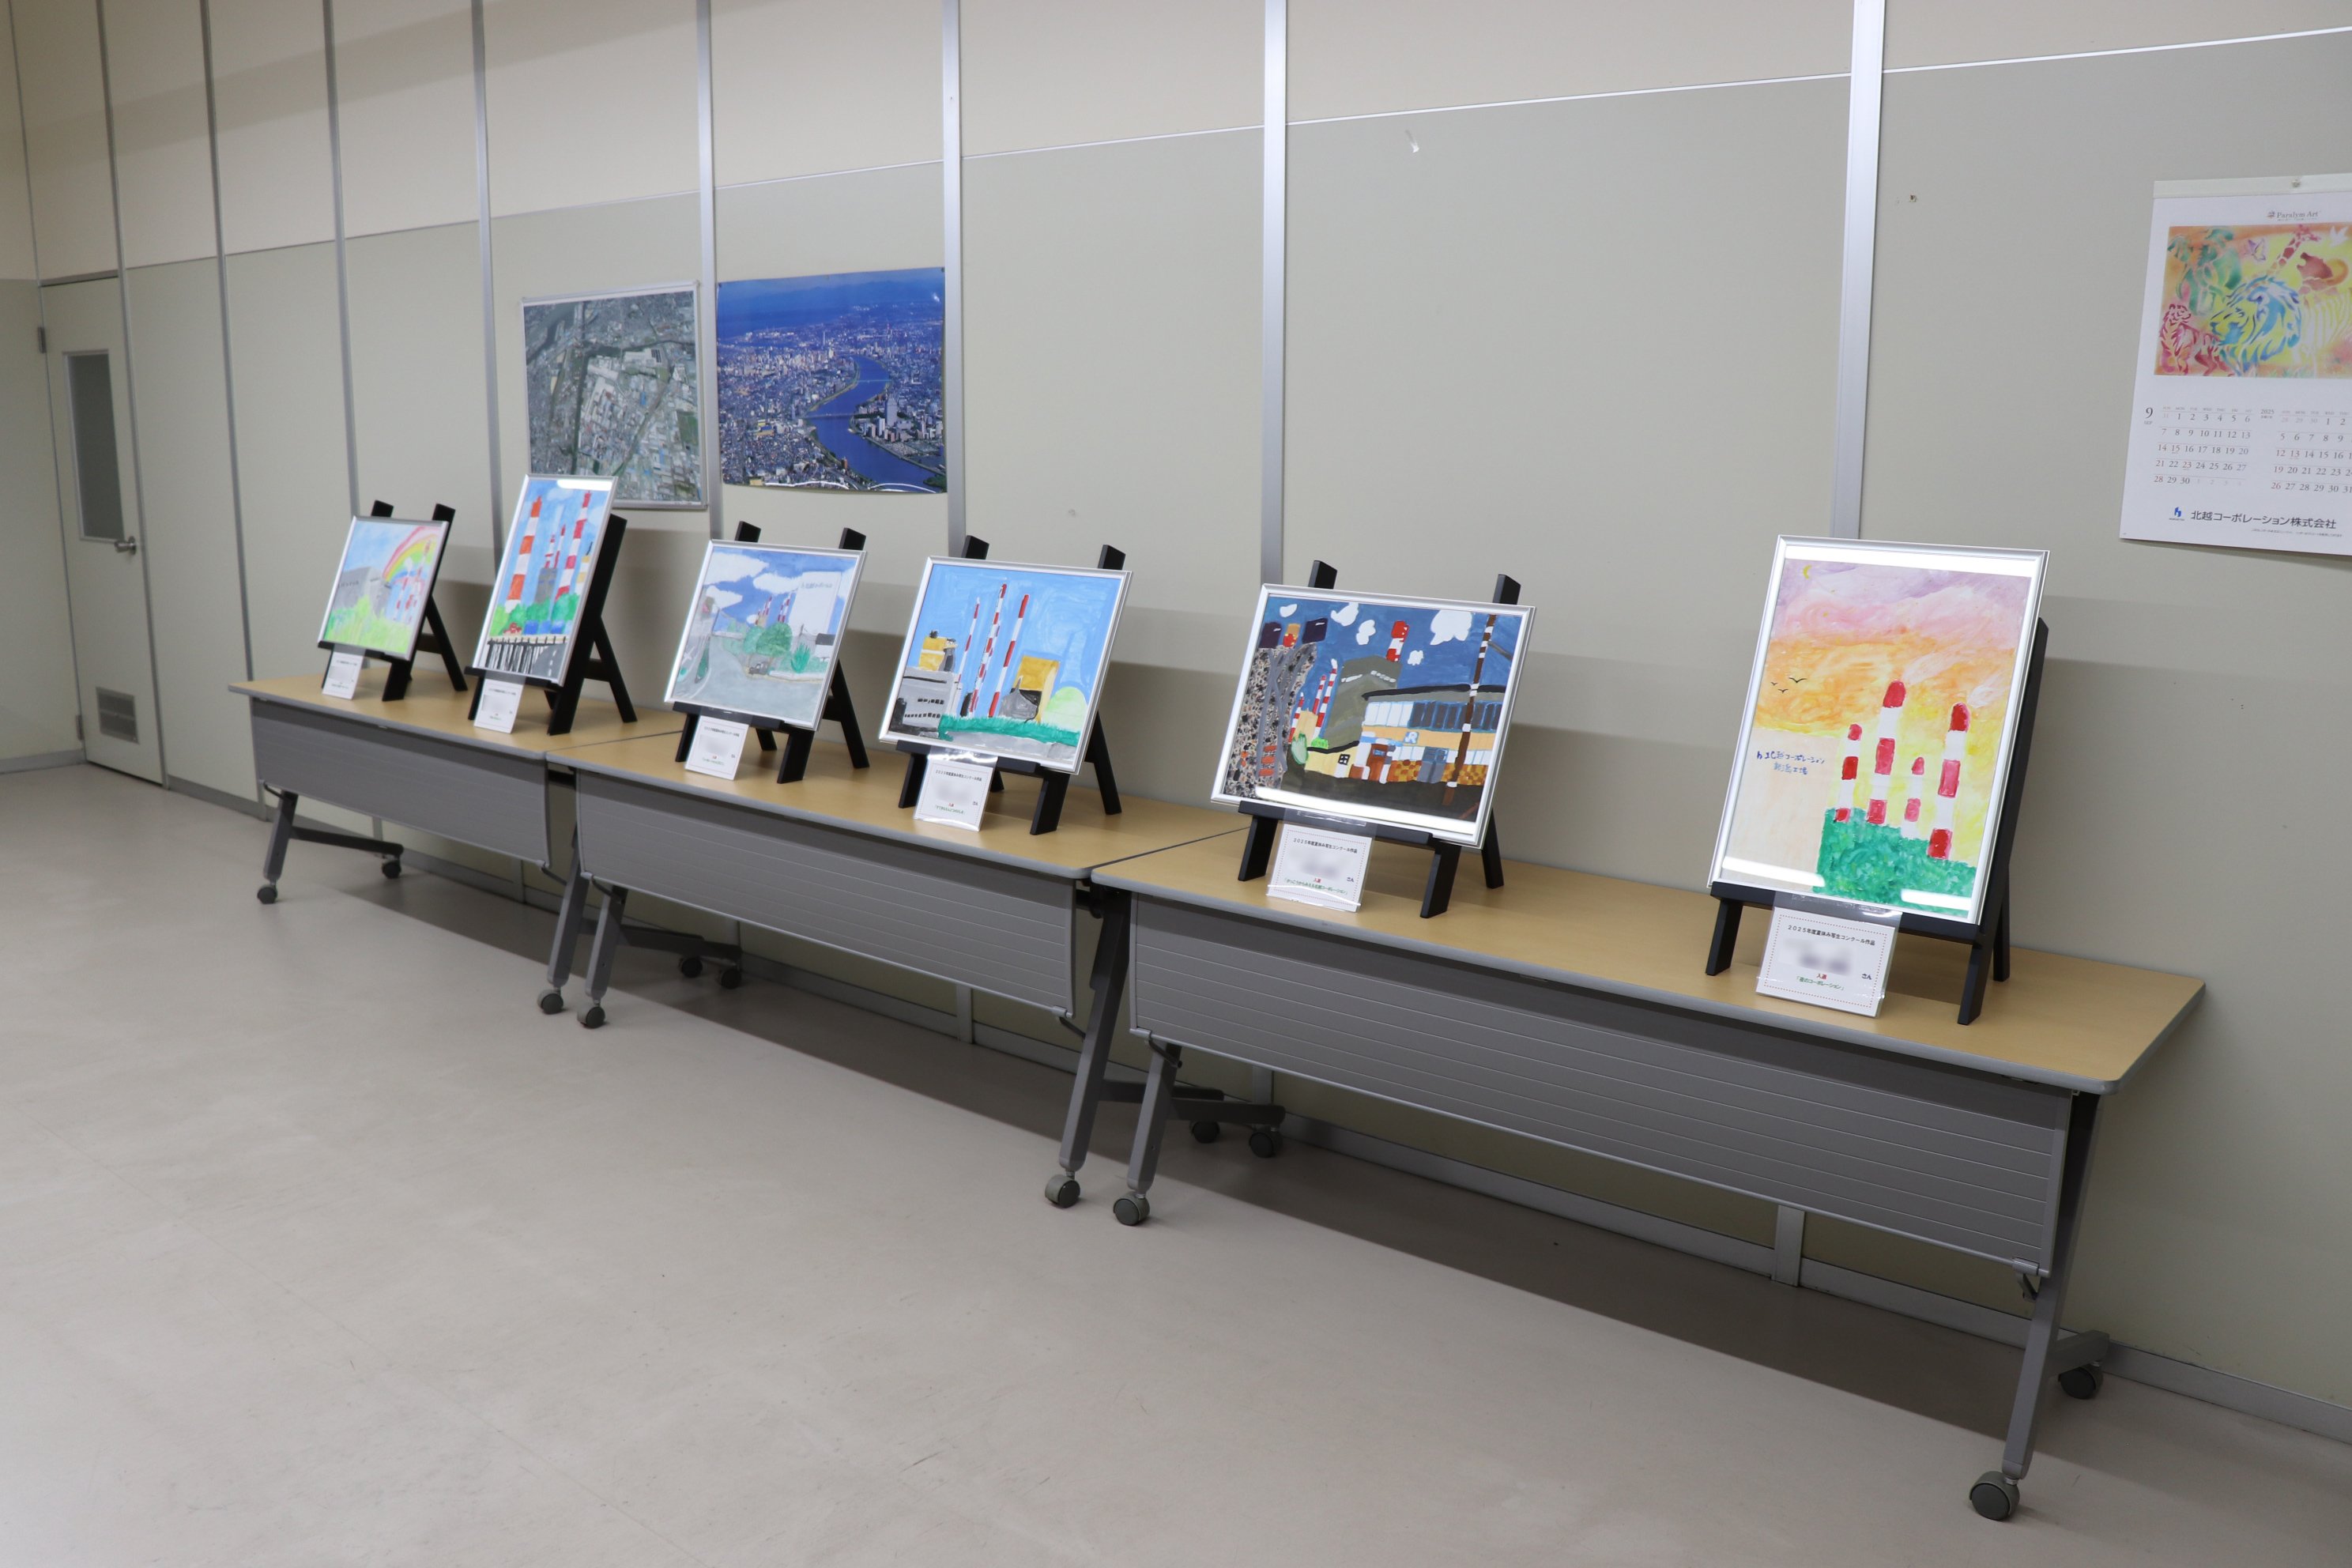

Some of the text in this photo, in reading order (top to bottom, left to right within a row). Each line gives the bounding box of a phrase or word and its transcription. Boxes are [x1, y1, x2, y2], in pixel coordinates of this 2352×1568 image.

[2145, 407, 2153, 419] 9
[2191, 510, 2337, 529] 北越コーポレーション株式会社
